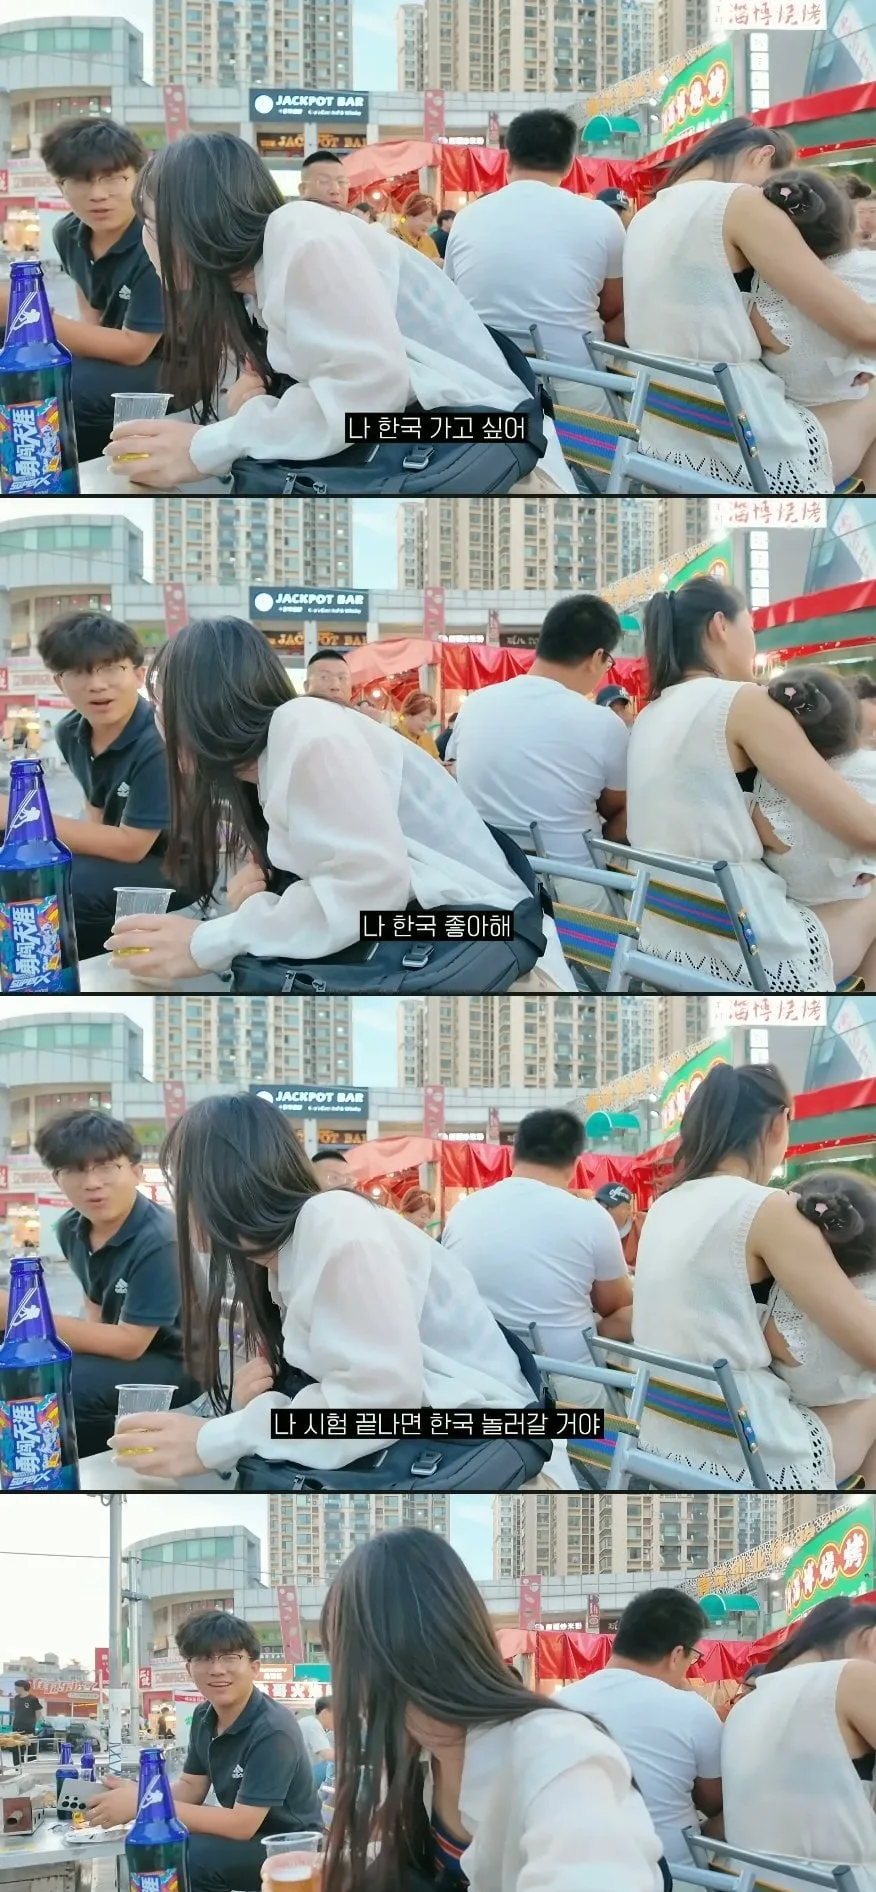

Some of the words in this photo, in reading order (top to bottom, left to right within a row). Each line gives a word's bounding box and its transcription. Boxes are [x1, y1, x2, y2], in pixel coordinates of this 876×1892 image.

[276, 95, 334, 106] JACKPOT
[337, 97, 364, 106] BAR
[276, 593, 334, 604] JACKPOT
[337, 595, 364, 604] BAR
[276, 1091, 334, 1102] JACKPOT
[337, 1093, 364, 1102] BAR
